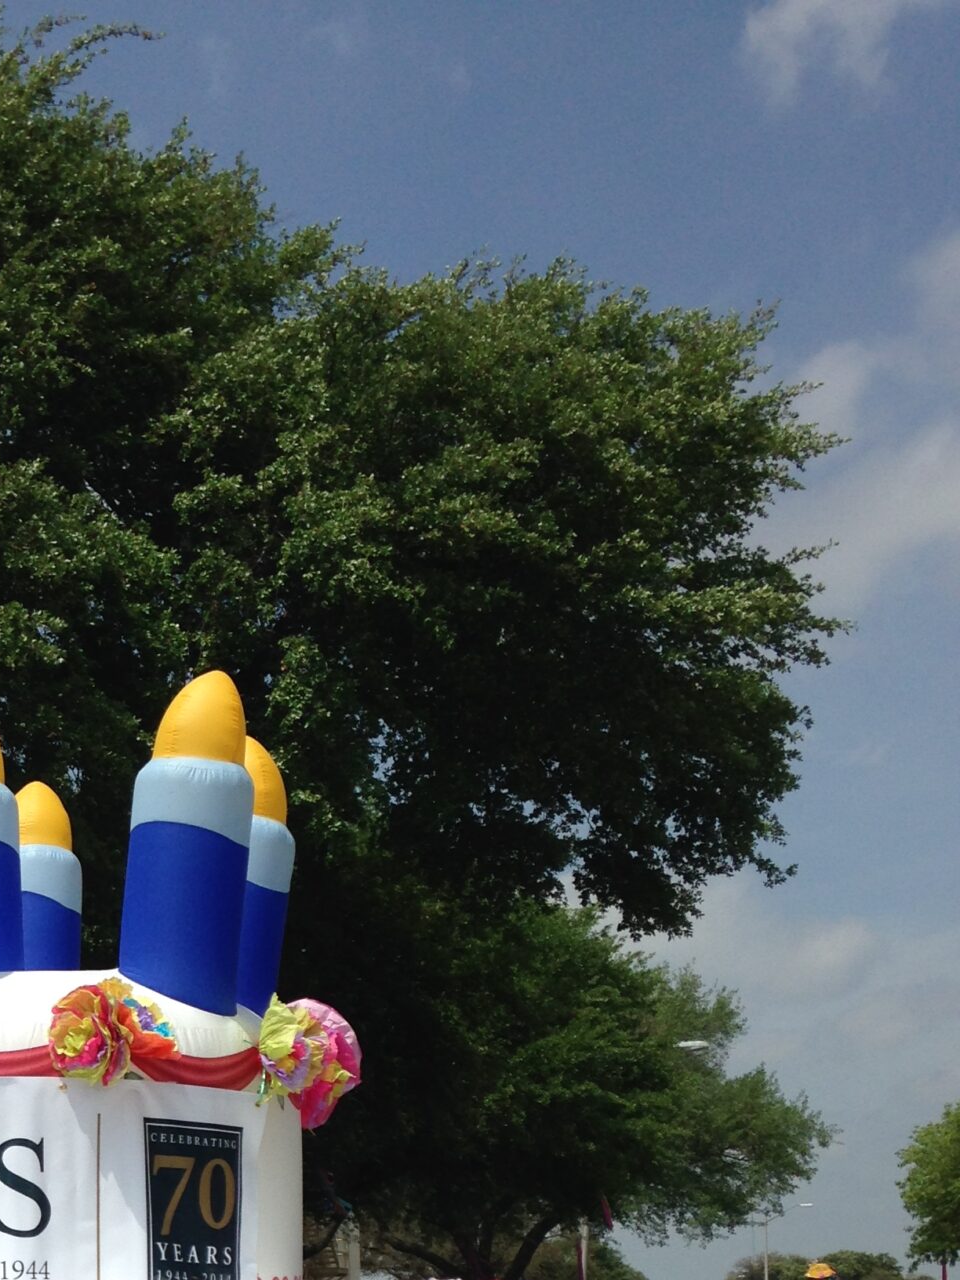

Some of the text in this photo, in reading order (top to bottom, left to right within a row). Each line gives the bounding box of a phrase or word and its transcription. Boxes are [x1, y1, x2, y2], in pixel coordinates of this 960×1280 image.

[150, 1132, 237, 1149] CELEBRATING
[152, 1154, 236, 1236] 70
[155, 1241, 233, 1266] YEARS
[0, 1259, 51, 1280] 1944
